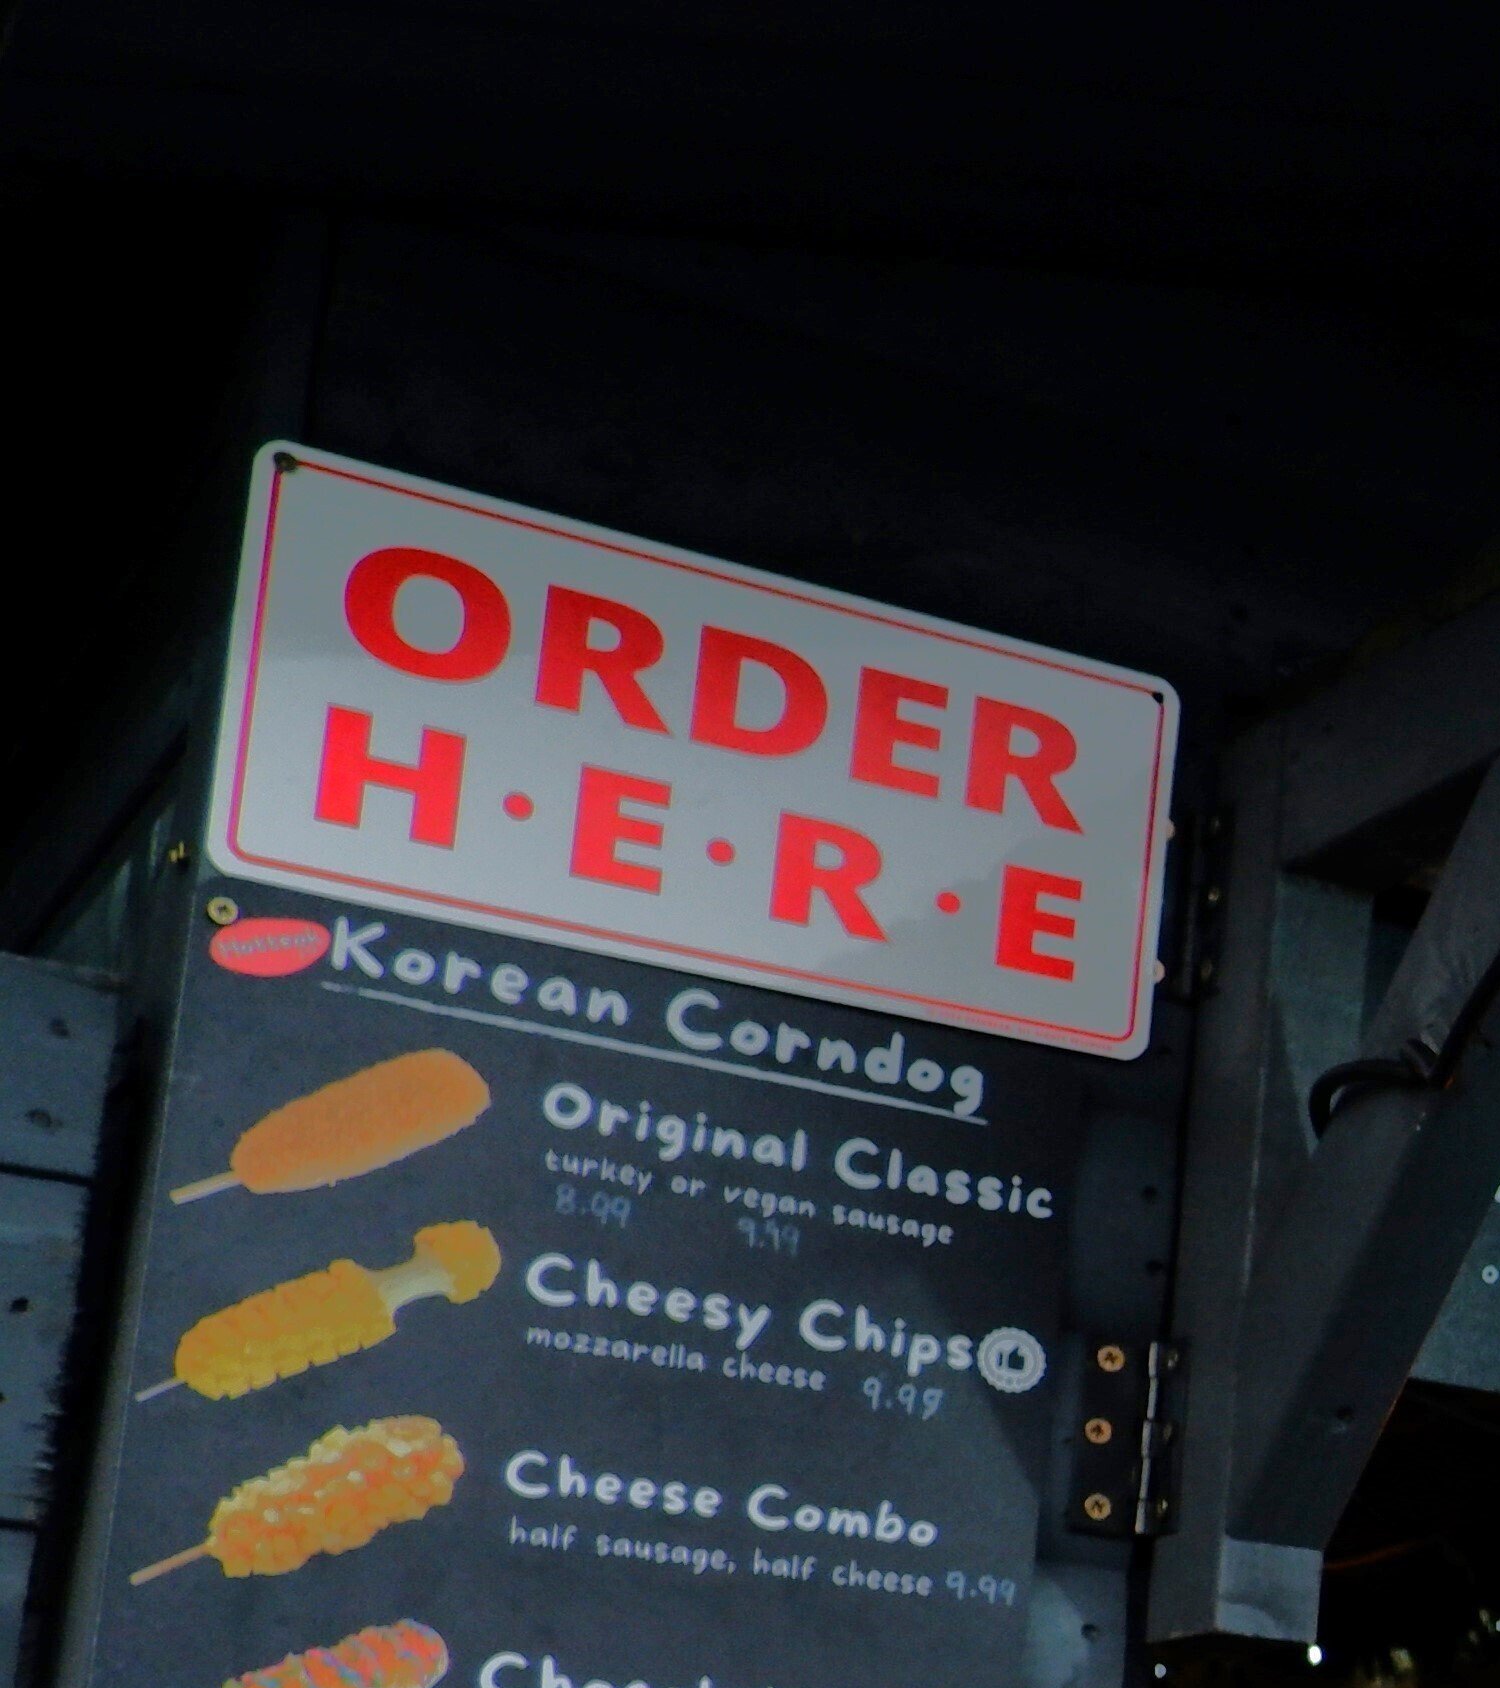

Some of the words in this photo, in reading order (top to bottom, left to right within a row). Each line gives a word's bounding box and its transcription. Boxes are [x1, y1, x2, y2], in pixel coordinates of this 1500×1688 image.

[342, 545, 1087, 837] ORDER
[328, 916, 629, 1027] Korean
[666, 988, 987, 1116] Corndog
[542, 1082, 809, 1172] Original
[834, 1137, 1055, 1220] Classic
[545, 1147, 655, 1197] turkey
[670, 1173, 706, 1195] or
[724, 1182, 817, 1222] vegan
[833, 1204, 955, 1249] sausage
[525, 1252, 771, 1349] Cheesy
[800, 1299, 973, 1375] Chips
[527, 1324, 706, 1372] mozzarella
[722, 1349, 825, 1392] cheese
[863, 1376, 944, 1420] 9.99
[505, 1449, 723, 1519] Cheese
[747, 1483, 937, 1548] Combo
[510, 1516, 577, 1550] half
[596, 1531, 736, 1577] sausage,
[753, 1547, 816, 1582] half
[832, 1562, 933, 1597] cheese
[945, 1569, 1016, 1606] 9.99
